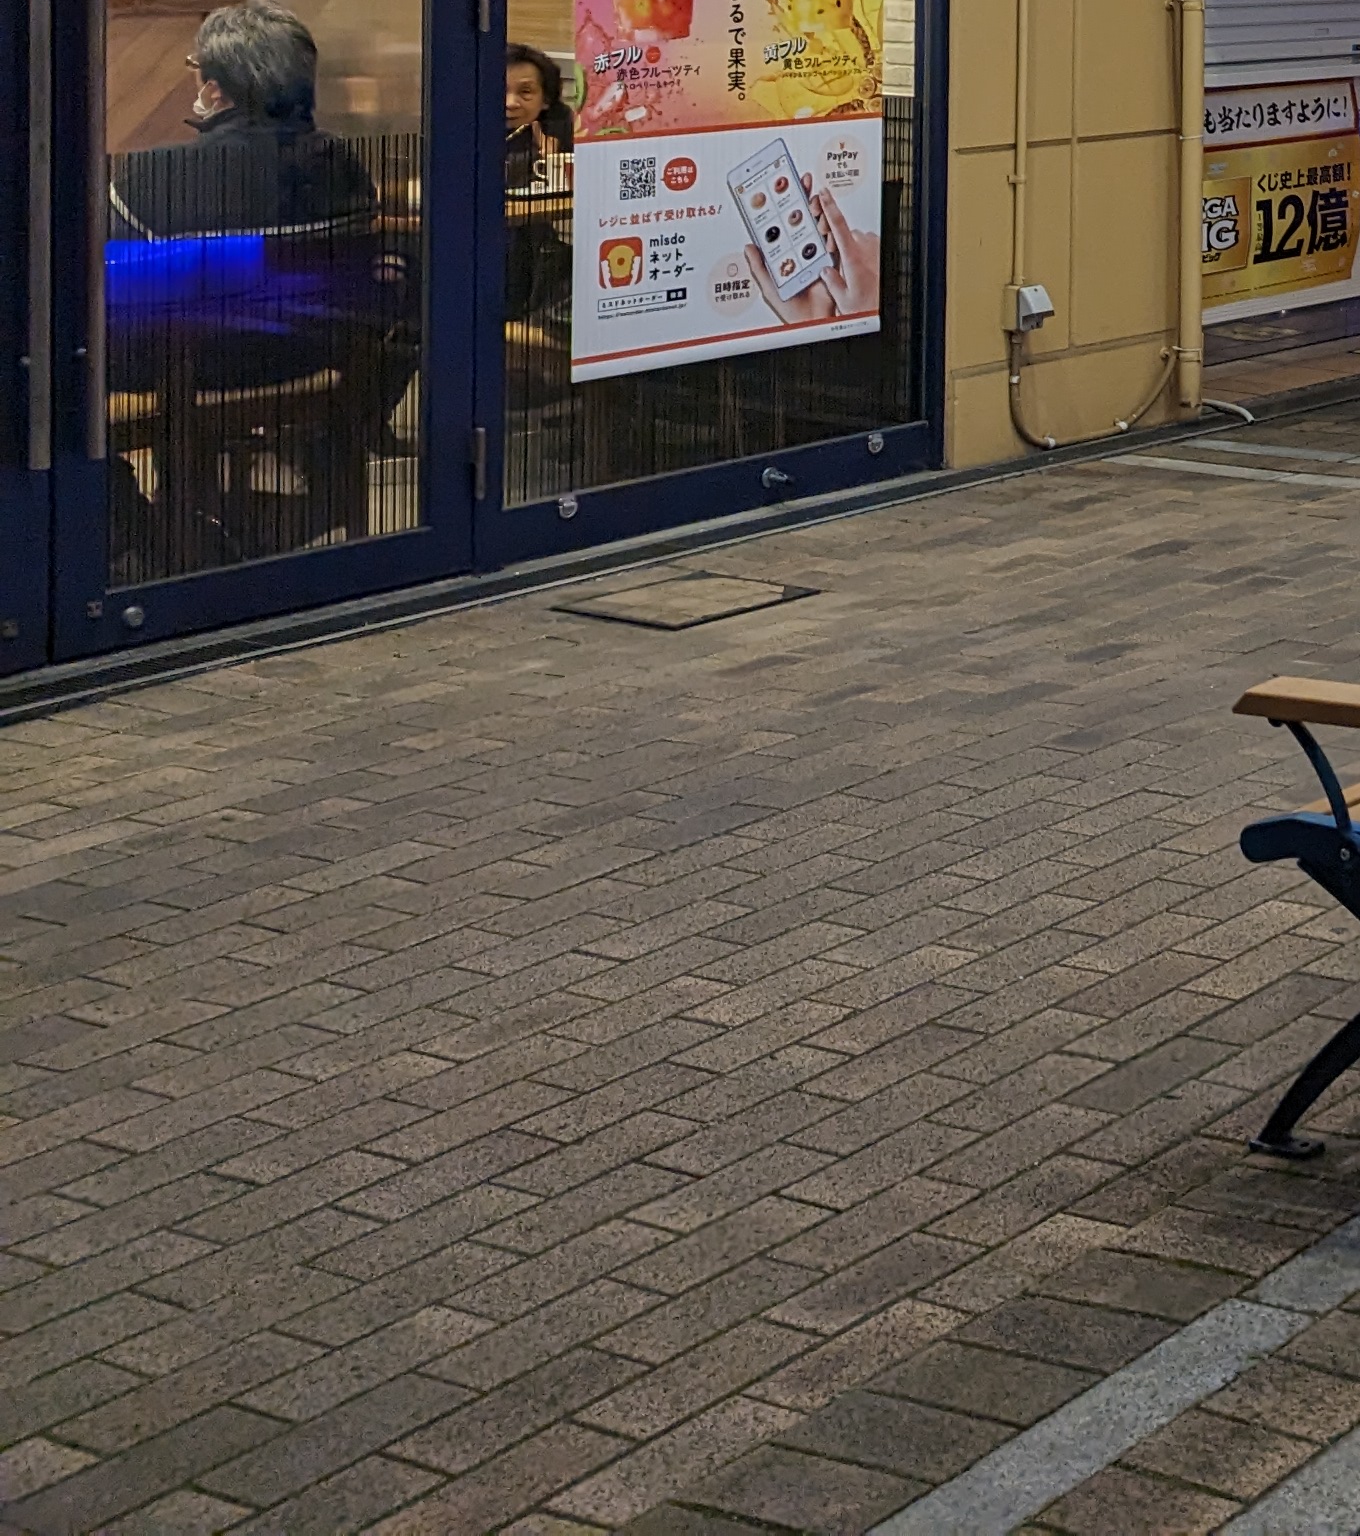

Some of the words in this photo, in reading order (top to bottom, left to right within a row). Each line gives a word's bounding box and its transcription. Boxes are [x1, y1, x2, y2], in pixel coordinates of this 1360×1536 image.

[594, 44, 643, 75] 赤フル
[763, 36, 808, 65] 黄フル
[782, 55, 858, 71] 黄色フルーツティ
[616, 65, 701, 82] 赤色フルーツティ
[826, 150, 858, 163] PayPay
[598, 204, 723, 228] レジに並ばず受け取れる!
[1252, 186, 1349, 265] 12億
[649, 232, 686, 248] misdo
[649, 247, 684, 265] ネット
[649, 263, 695, 281] オーダー
[714, 278, 751, 294] 日時指定
